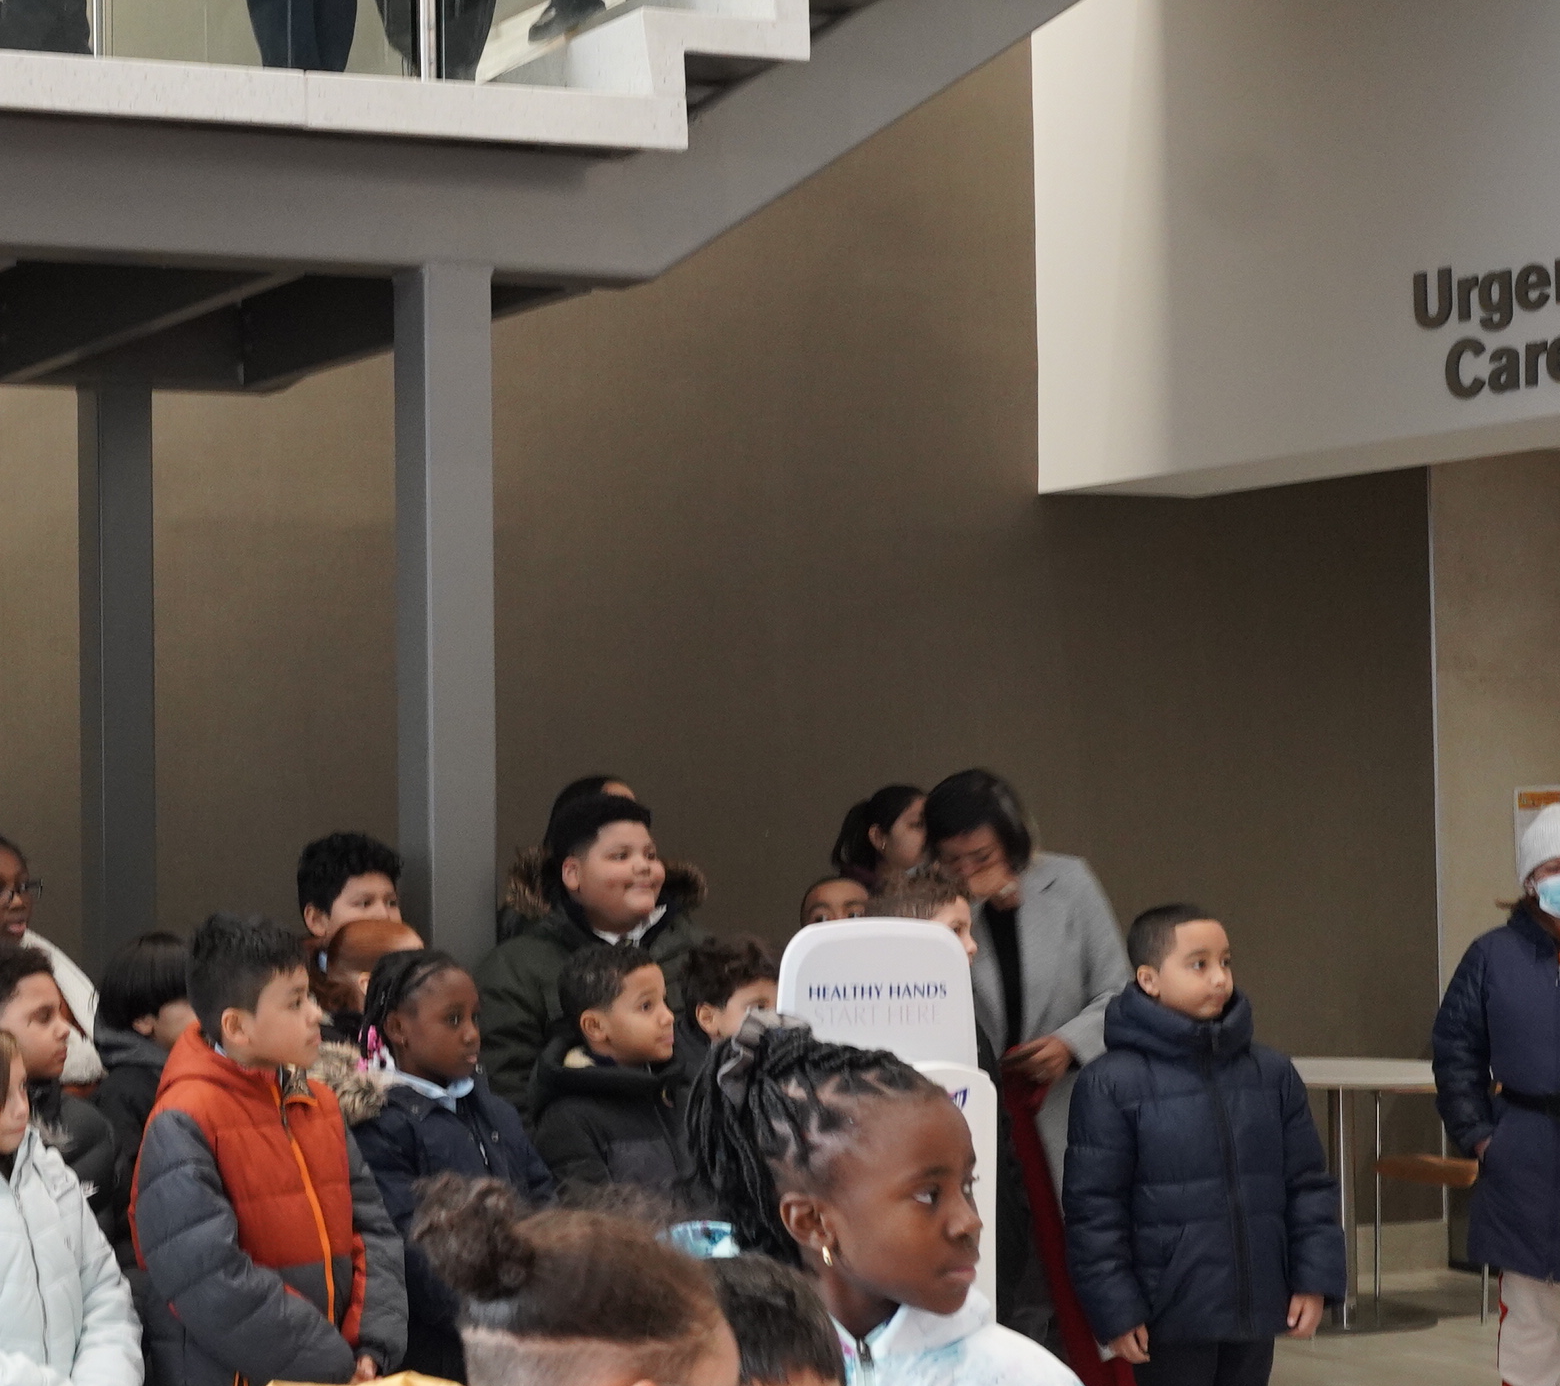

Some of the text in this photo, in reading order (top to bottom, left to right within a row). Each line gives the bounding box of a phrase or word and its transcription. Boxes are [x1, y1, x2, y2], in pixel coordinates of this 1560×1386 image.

[808, 981, 947, 1003] HEALTHY HANDS
[814, 1003, 942, 1028] START HERE
